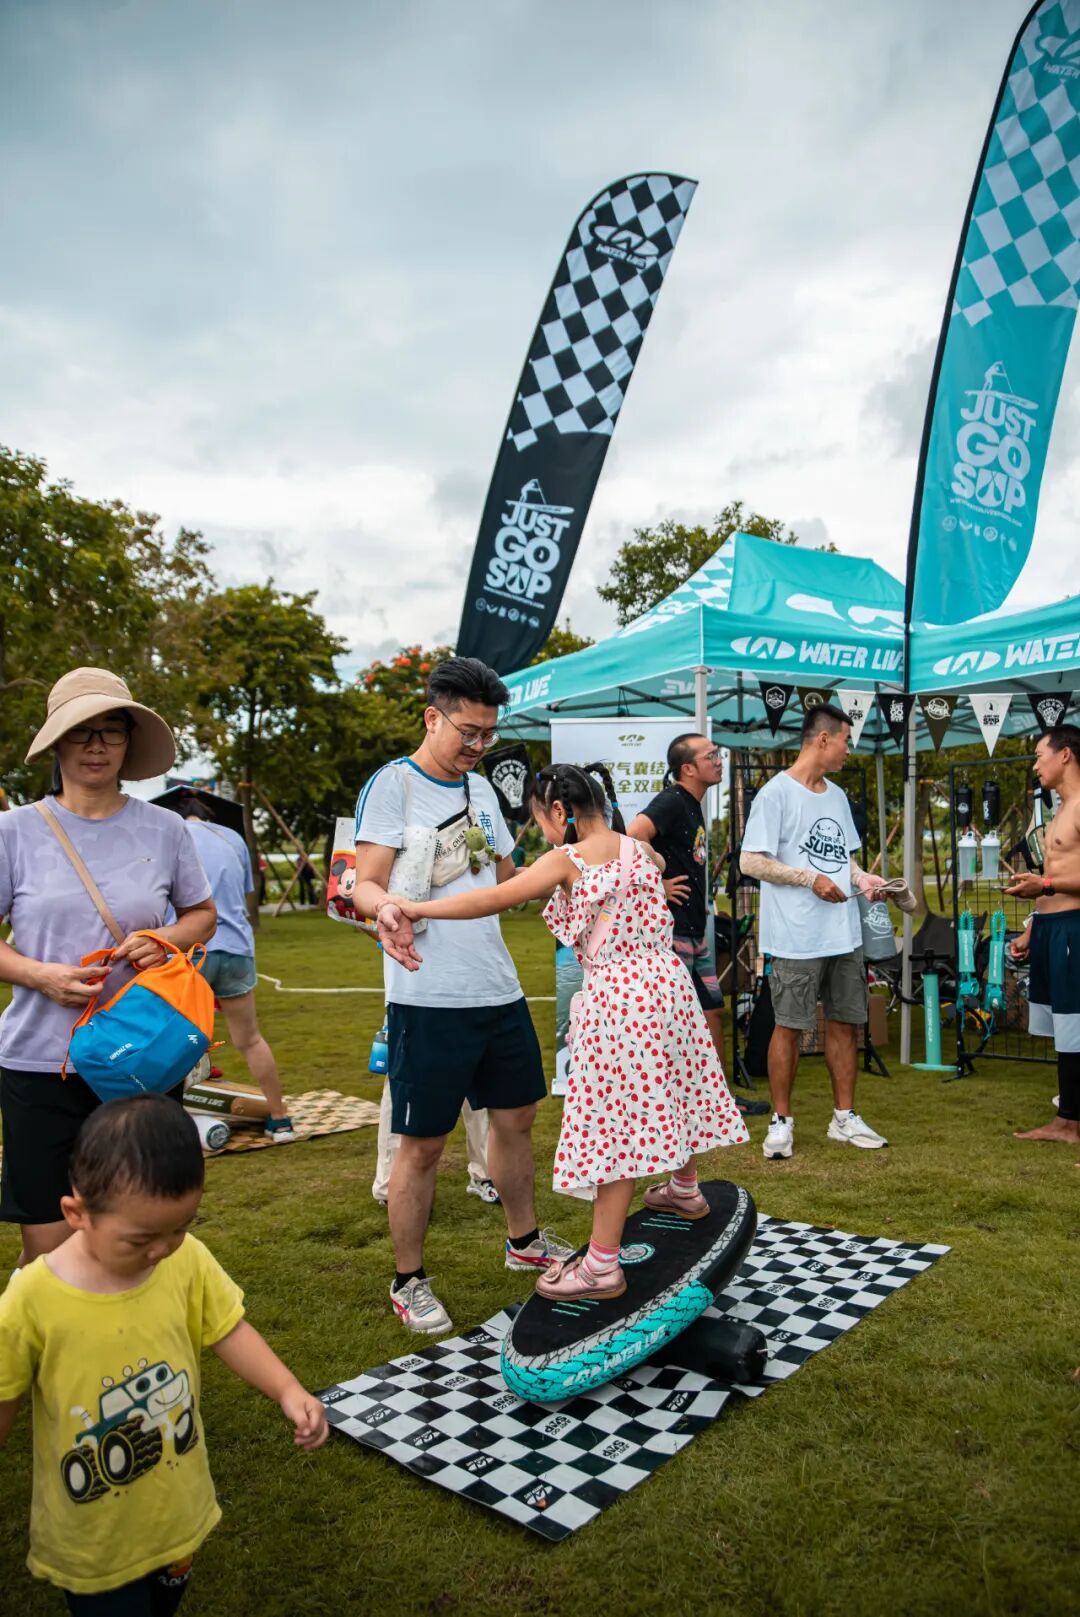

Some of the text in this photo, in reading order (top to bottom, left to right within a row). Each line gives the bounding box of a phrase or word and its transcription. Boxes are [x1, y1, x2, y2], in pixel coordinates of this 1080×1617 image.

[960, 391, 1037, 443] JUST
[956, 421, 1031, 481] GO
[951, 462, 1026, 514] SUP
[501, 502, 571, 543] JUST
[494, 525, 561, 573] GO
[485, 557, 552, 600] SUP
[798, 640, 869, 669] WATER
[804, 835, 848, 860] SUPER
